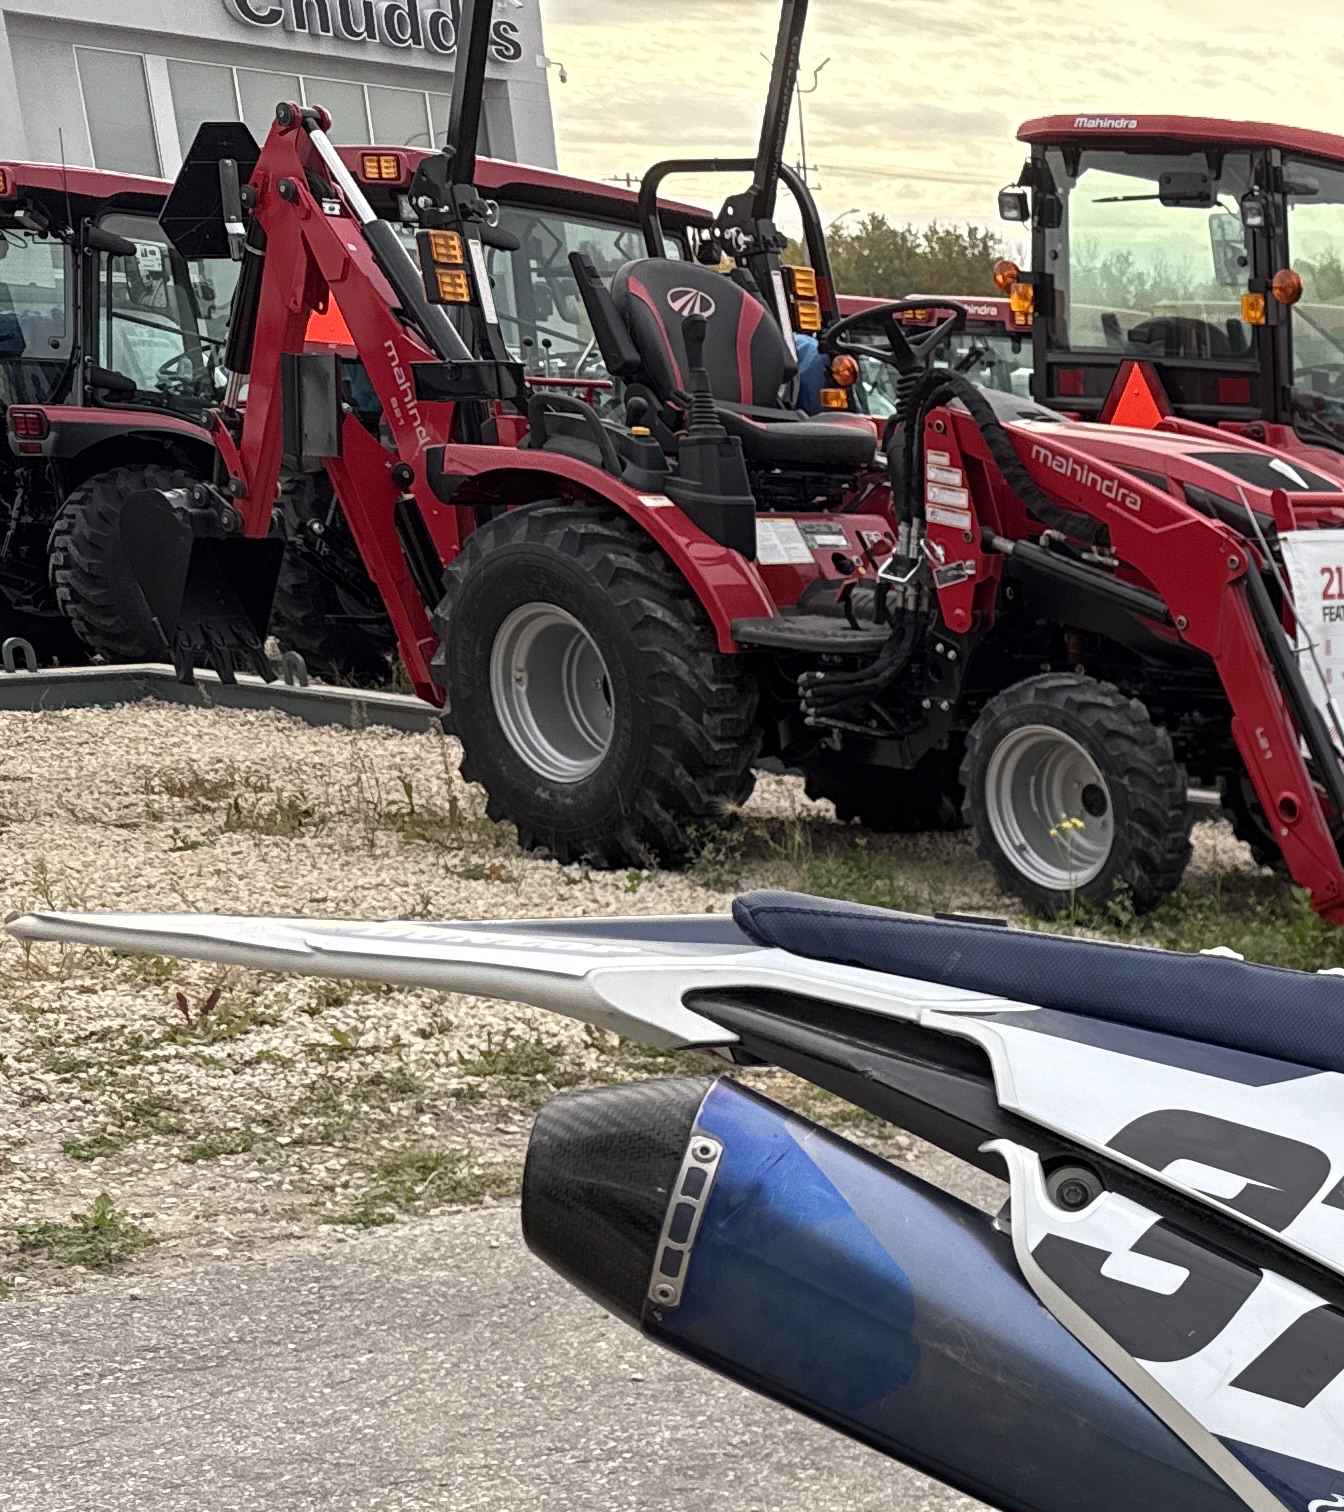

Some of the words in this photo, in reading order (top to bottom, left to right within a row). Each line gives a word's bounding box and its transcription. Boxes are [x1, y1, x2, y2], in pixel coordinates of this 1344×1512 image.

[963, 303, 997, 315] hindra
[384, 340, 431, 445] mahind
[1031, 444, 1141, 512] mahindra
